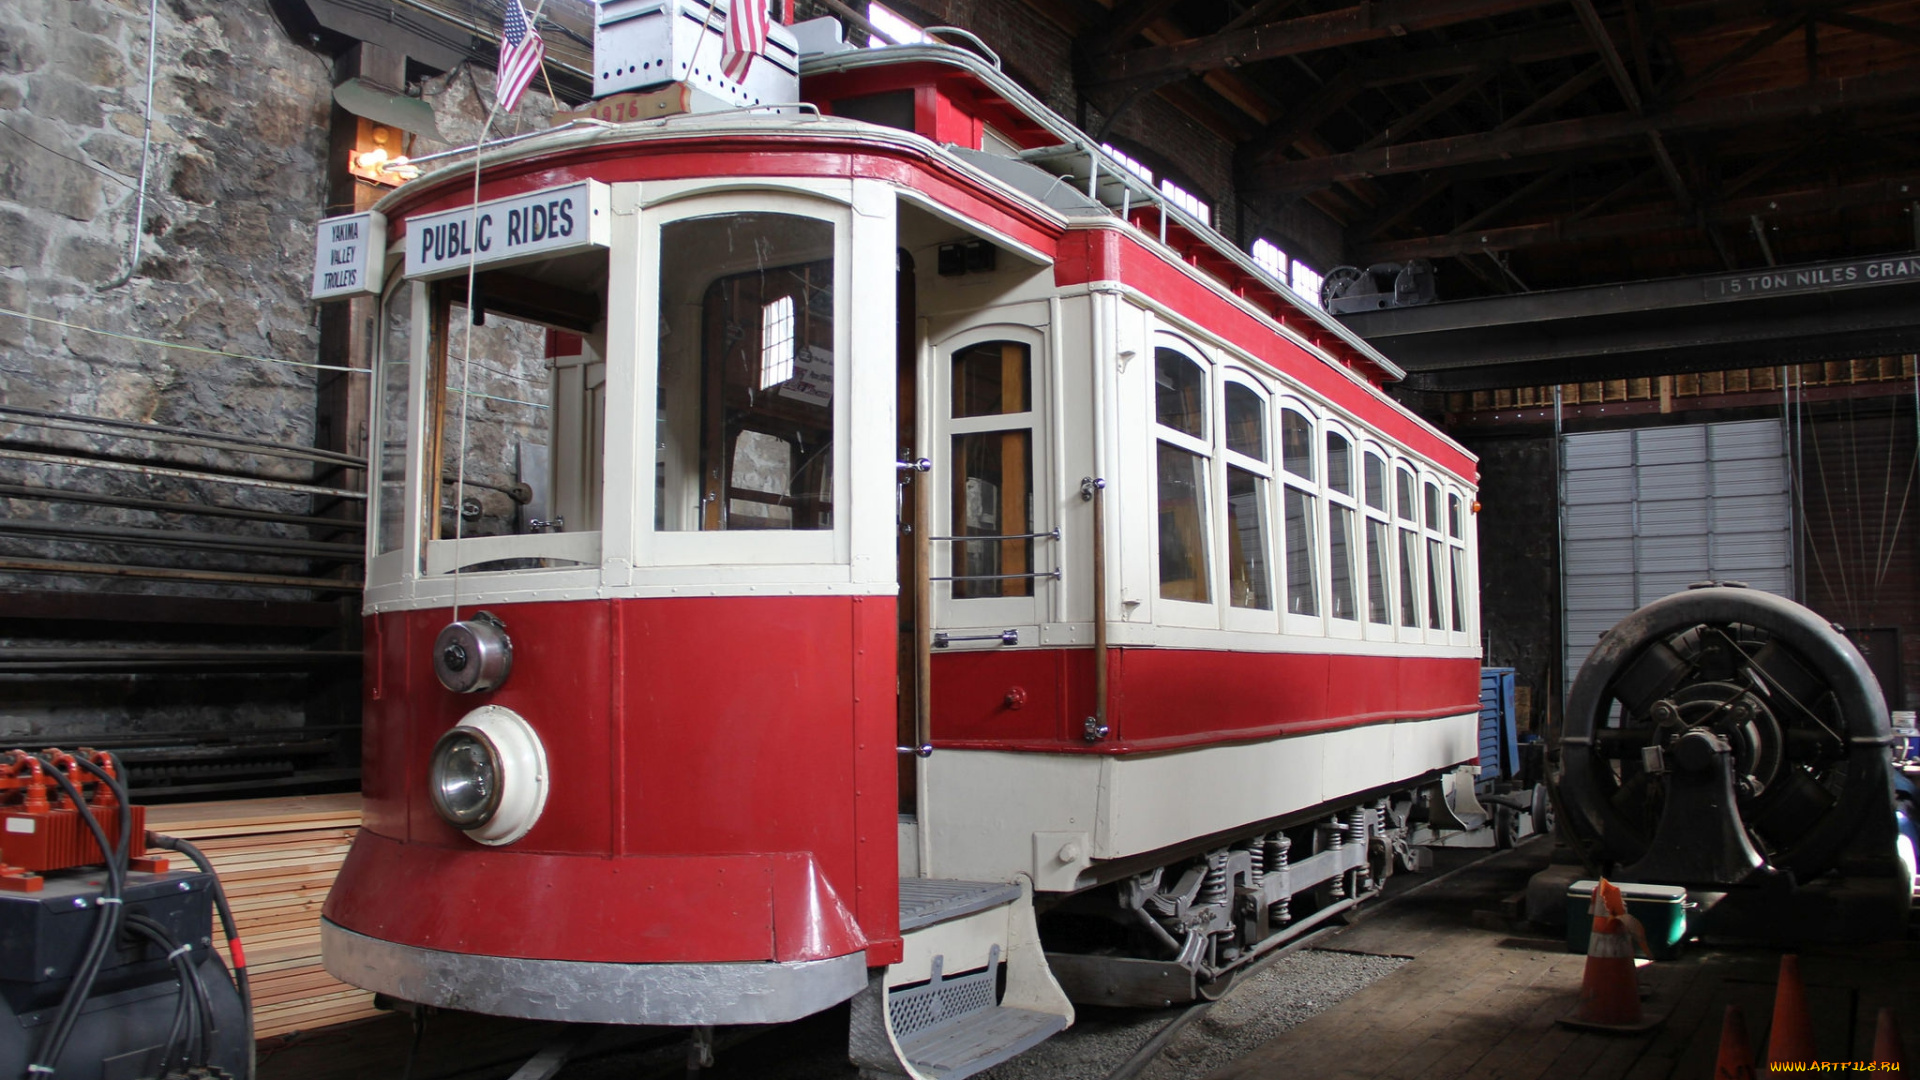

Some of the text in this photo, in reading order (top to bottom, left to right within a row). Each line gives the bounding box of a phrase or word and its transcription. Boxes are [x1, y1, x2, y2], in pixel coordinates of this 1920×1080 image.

[590, 100, 638, 122] 1976
[332, 222, 358, 243] YAKIMA
[507, 198, 574, 247] RIDES
[330, 246, 356, 266] VALLEY
[323, 269, 357, 290] TROLLEYS
[1720, 279, 1742, 295] 15
[1748, 275, 1788, 291] TON
[1796, 266, 1857, 285] NILES
